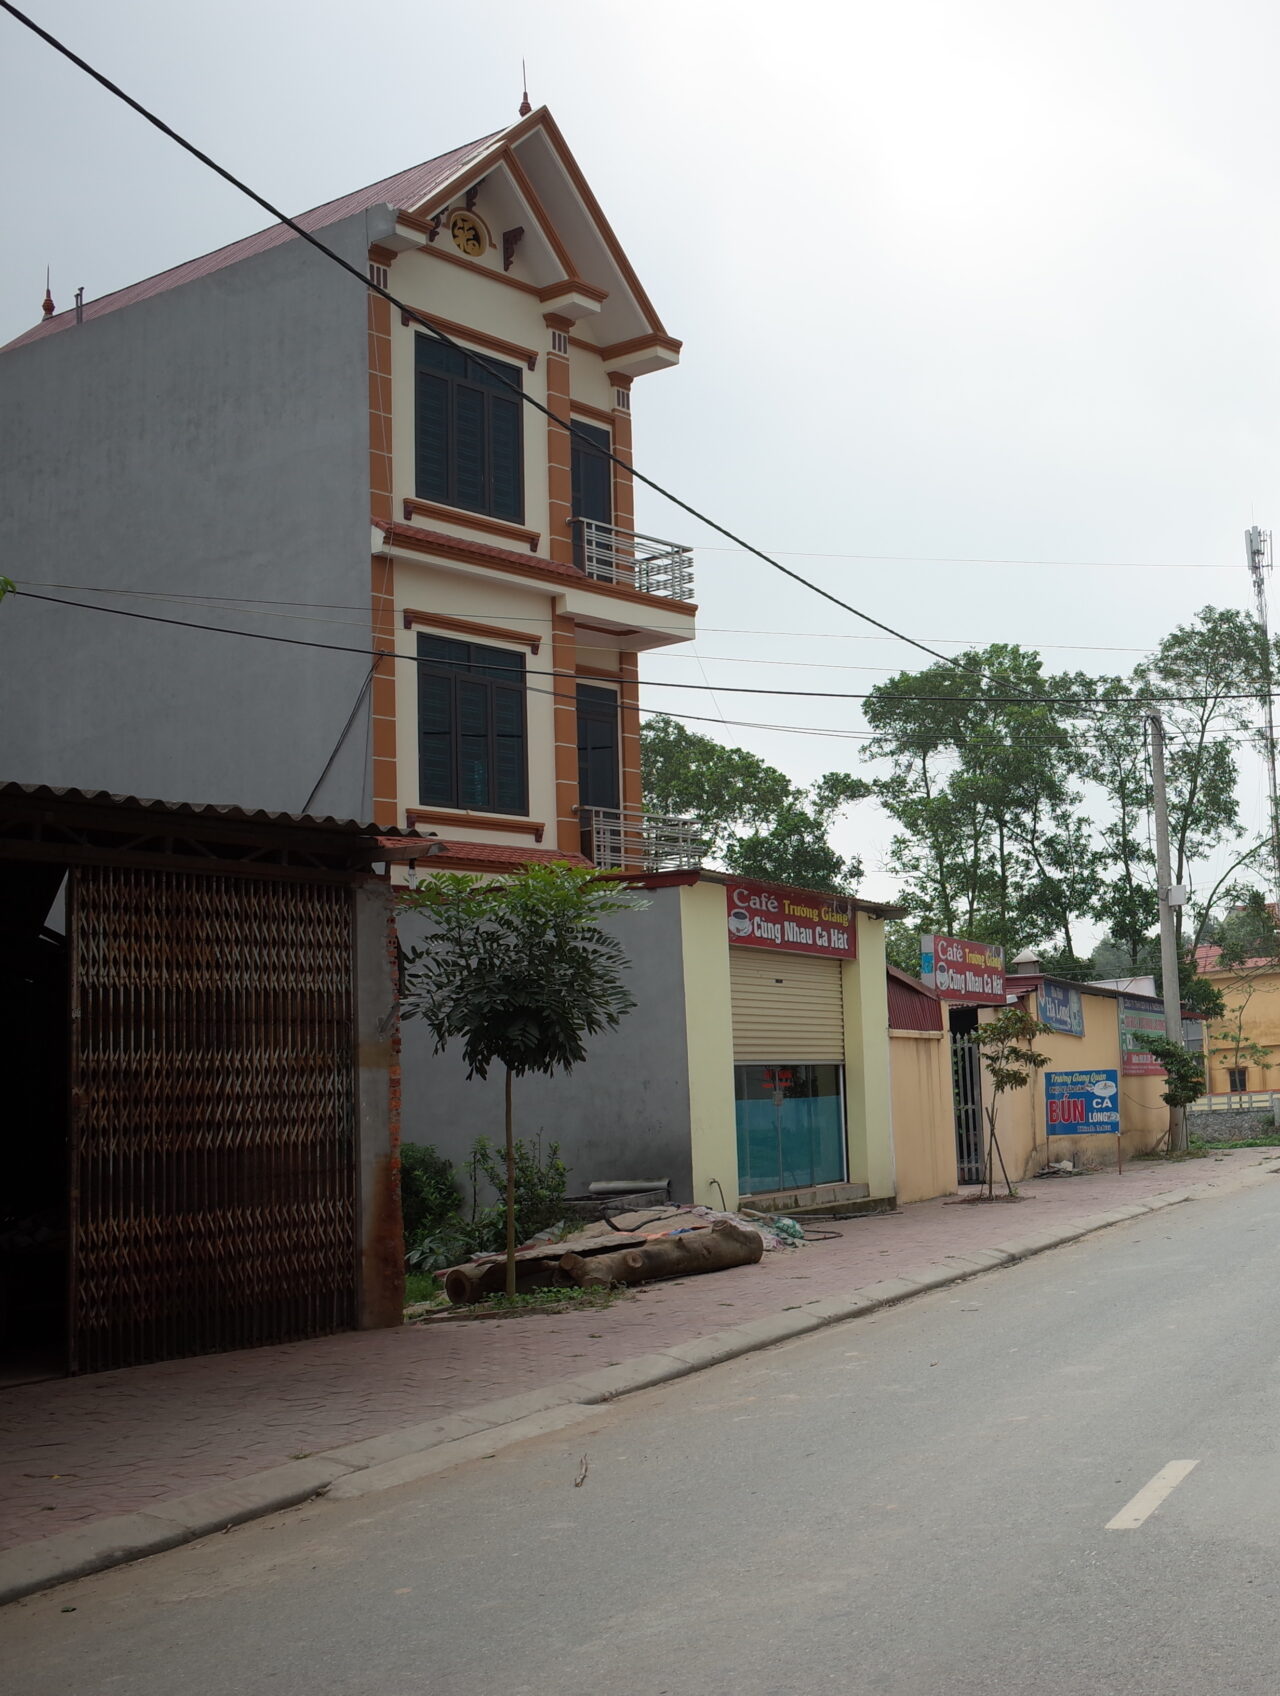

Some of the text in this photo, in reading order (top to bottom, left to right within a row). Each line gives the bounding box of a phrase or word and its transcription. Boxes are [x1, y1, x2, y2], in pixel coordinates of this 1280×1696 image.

[733, 888, 849, 927] Café Trường Giang
[753, 916, 848, 950] Cùng Nhau Ca Hát
[938, 940, 963, 962] Café
[948, 968, 1003, 994] Cùng Nhau Ca Hát
[1055, 999, 1072, 1028] Long
[1048, 1093, 1085, 1124] BÚN
